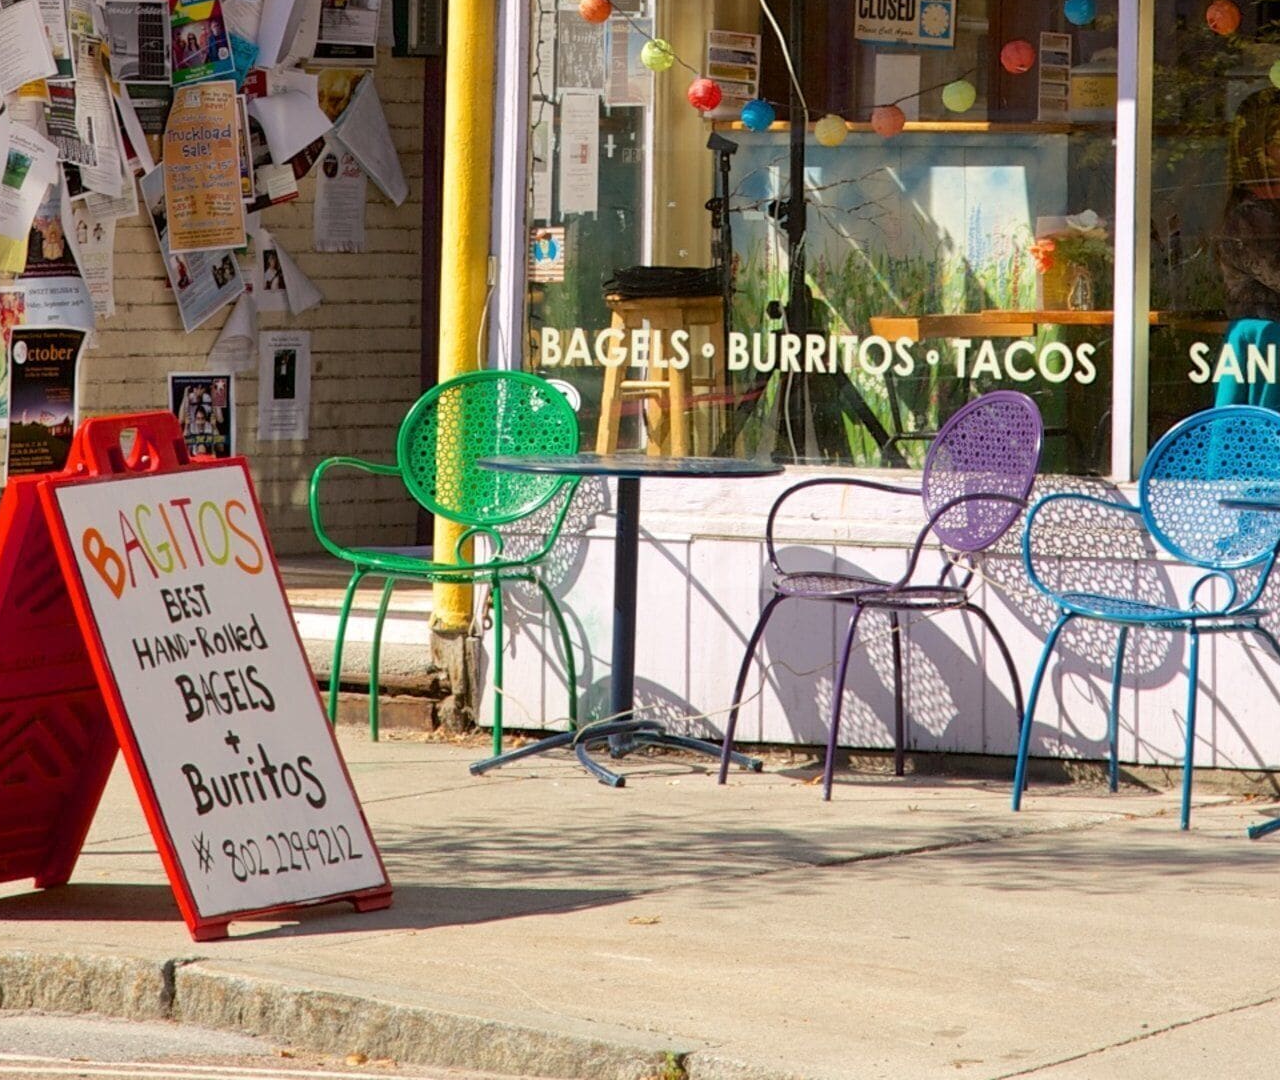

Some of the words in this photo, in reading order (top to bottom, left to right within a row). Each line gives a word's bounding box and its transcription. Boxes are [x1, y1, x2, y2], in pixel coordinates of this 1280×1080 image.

[168, 124, 232, 143] Truckload
[182, 142, 212, 158] Sale!
[541, 326, 691, 372] BAGELS
[726, 331, 915, 378] BURRITOS
[952, 338, 1096, 386] TACOS
[83, 497, 264, 600] BAGITOS
[161, 584, 212, 623] BEST
[132, 614, 268, 670] HAND-Rolled
[175, 665, 275, 723] BAGELS
[182, 743, 327, 816] Burritos
[223, 838, 270, 883] 802
